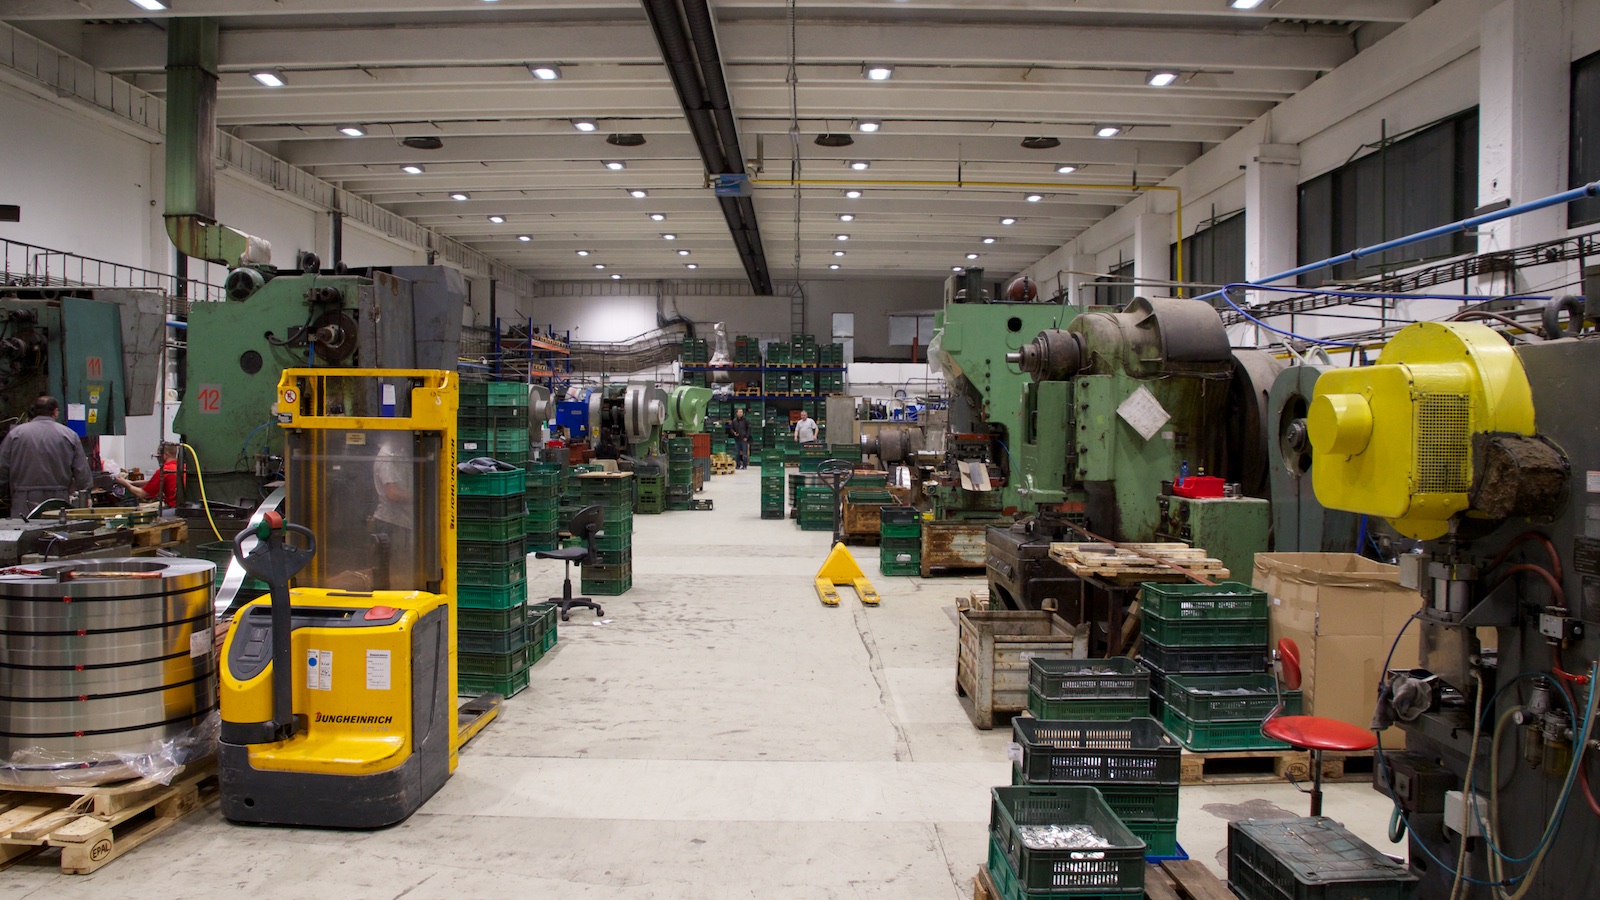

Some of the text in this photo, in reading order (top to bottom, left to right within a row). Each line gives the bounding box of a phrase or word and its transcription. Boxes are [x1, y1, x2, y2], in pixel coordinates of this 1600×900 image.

[88, 358, 101, 376] 11
[197, 389, 219, 410] 12
[315, 711, 393, 724] JUNGHEINRICH
[92, 842, 110, 859] EPAL
